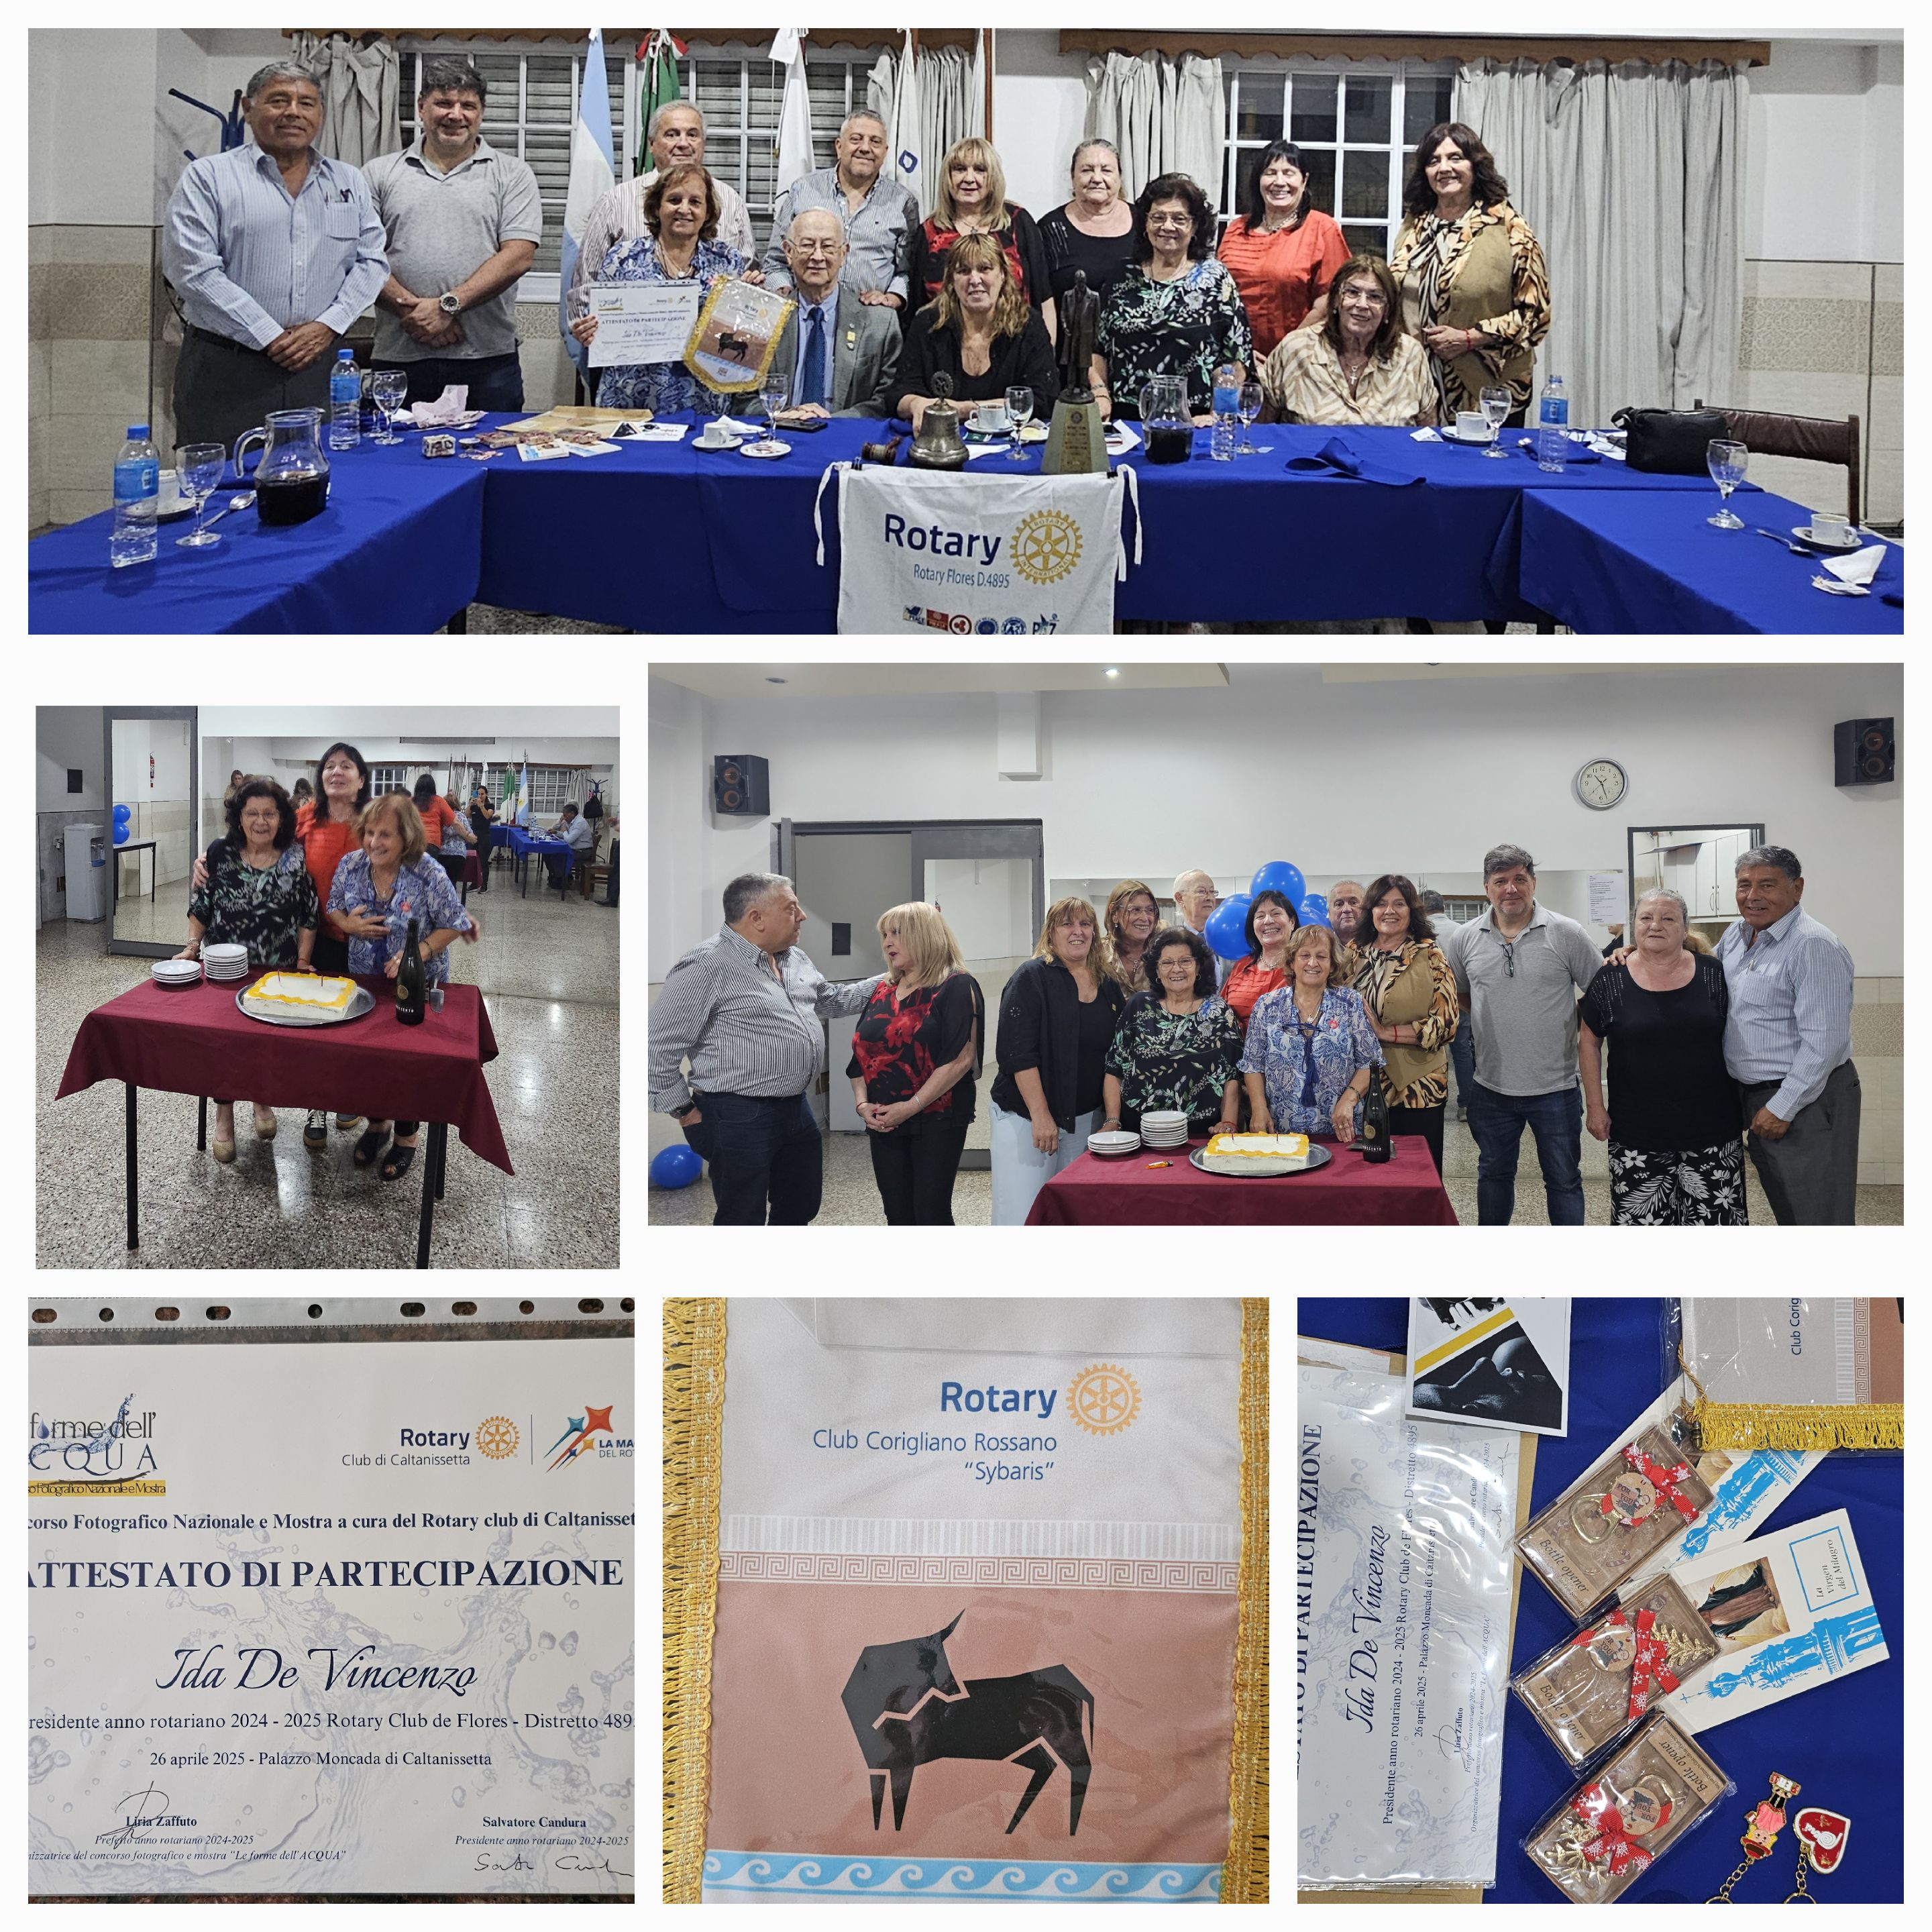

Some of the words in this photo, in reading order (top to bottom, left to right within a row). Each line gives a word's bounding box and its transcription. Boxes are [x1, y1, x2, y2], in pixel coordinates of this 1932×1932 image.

[885, 513, 1002, 568] Rotary
[914, 564, 945, 586] Rotary
[947, 568, 975, 586] Flores
[977, 571, 1010, 588] D.4895
[1790, 1329, 1802, 1356] Club
[941, 1382, 1057, 1419] Rotary
[401, 1429, 470, 1450] Rotary
[599, 1440, 613, 1448] LA
[616, 1440, 635, 1448] MA
[813, 1430, 858, 1449] Club
[866, 1431, 967, 1455] Corigliano
[975, 1433, 1057, 1451] Rossano
[1407, 1425, 1417, 1449] 4895
[342, 1454, 370, 1466] Club
[376, 1454, 386, 1465] di
[391, 1454, 470, 1465] Caltanissetta
[599, 1450, 616, 1458] DEL
[1404, 1452, 1417, 1498] Distretto
[37, 1483, 85, 1497] Fotografico
[86, 1483, 127, 1494] Nazionale
[136, 1483, 166, 1494] Mostra
[1617, 1483, 1631, 1495] FOR
[1620, 1493, 1633, 1505] YOU
[73, 1514, 167, 1533] Fotografico
[174, 1514, 254, 1529] Nazionale
[259, 1517, 268, 1529] e
[273, 1513, 332, 1529] Mostra
[337, 1517, 347, 1529] a
[352, 1517, 387, 1529] cura
[392, 1513, 416, 1528] del
[422, 1512, 478, 1531] Rotary
[484, 1512, 518, 1527] club
[523, 1511, 538, 1527] di
[1401, 1544, 1411, 1556] de
[1827, 1540, 1842, 1574] Milagro
[242, 1561, 281, 1588] DI
[291, 1559, 623, 1588] PARTECIPAZIONE
[1399, 1560, 1410, 1584] Club
[1540, 1539, 1564, 1565] Bottle
[1562, 1566, 1589, 1592] opener
[1352, 1525, 1391, 1634] Vincenzo
[1424, 1579, 1433, 1588] di
[1821, 1564, 1835, 1594] Virgen
[1835, 1576, 1846, 1590] del
[1816, 1587, 1824, 1597] La
[1397, 1587, 1411, 1623] Rotary
[1421, 1587, 1433, 1631] Moncada
[1395, 1626, 1405, 1651] 2025
[1601, 1640, 1614, 1654] YOU
[1603, 1632, 1614, 1645] OR
[1349, 1640, 1379, 1683] De
[1419, 1634, 1429, 1668] Palazzo
[156, 1645, 227, 1689] Ida
[234, 1648, 299, 1689] De
[307, 1645, 478, 1697] Vincenzo
[1393, 1660, 1403, 1686] 2024
[1417, 1677, 1427, 1698] 2025
[105, 1717, 145, 1729] anno
[150, 1715, 225, 1729] rotariano
[231, 1713, 268, 1728] 2024
[284, 1713, 321, 1728] 2025
[327, 1713, 383, 1731] Rotary
[388, 1713, 428, 1728] Club
[433, 1713, 451, 1728] de
[457, 1713, 508, 1728] Flores
[525, 1713, 598, 1729] Distretto
[603, 1713, 635, 1729] 489
[1346, 1688, 1375, 1733] Ida
[1390, 1688, 1401, 1737] rotariano
[1415, 1700, 1428, 1724] aprile
[1454, 1707, 1464, 1733] Zaffuto
[1415, 1726, 1423, 1737] 26
[1453, 1733, 1462, 1753] Liria
[150, 1753, 166, 1765] 26
[170, 1753, 209, 1768] aprile
[213, 1752, 245, 1765] 2025
[258, 1752, 311, 1765] Palazzo
[316, 1752, 380, 1765] Moncada
[385, 1752, 398, 1765] di
[402, 1752, 492, 1765] Caltanissetta
[1389, 1740, 1399, 1766] anno
[1658, 1741, 1686, 1766] opener
[1470, 1788, 1480, 1832] Organizzatrice
[1475, 1716, 1485, 1749] fotografico
[1684, 1766, 1708, 1792] Bottle
[1383, 1768, 1395, 1825] Presidente
[1637, 1803, 1651, 1813] YOU
[126, 1816, 152, 1827] Liria
[156, 1816, 197, 1827] Zaffuto
[482, 1817, 535, 1828] Salvatore
[539, 1817, 586, 1828] Candura
[1641, 1813, 1656, 1823] FOR
[160, 1835, 203, 1845] rotariano
[205, 1835, 254, 1845] 2024-2025
[455, 1835, 504, 1845] Presidente
[506, 1837, 529, 1845] anno
[533, 1836, 577, 1845] rotariano
[580, 1836, 629, 1845] 2024-2025
[73, 1851, 87, 1860] del
[132, 1851, 184, 1863] fotografico
[248, 1850, 277, 1864] forme
